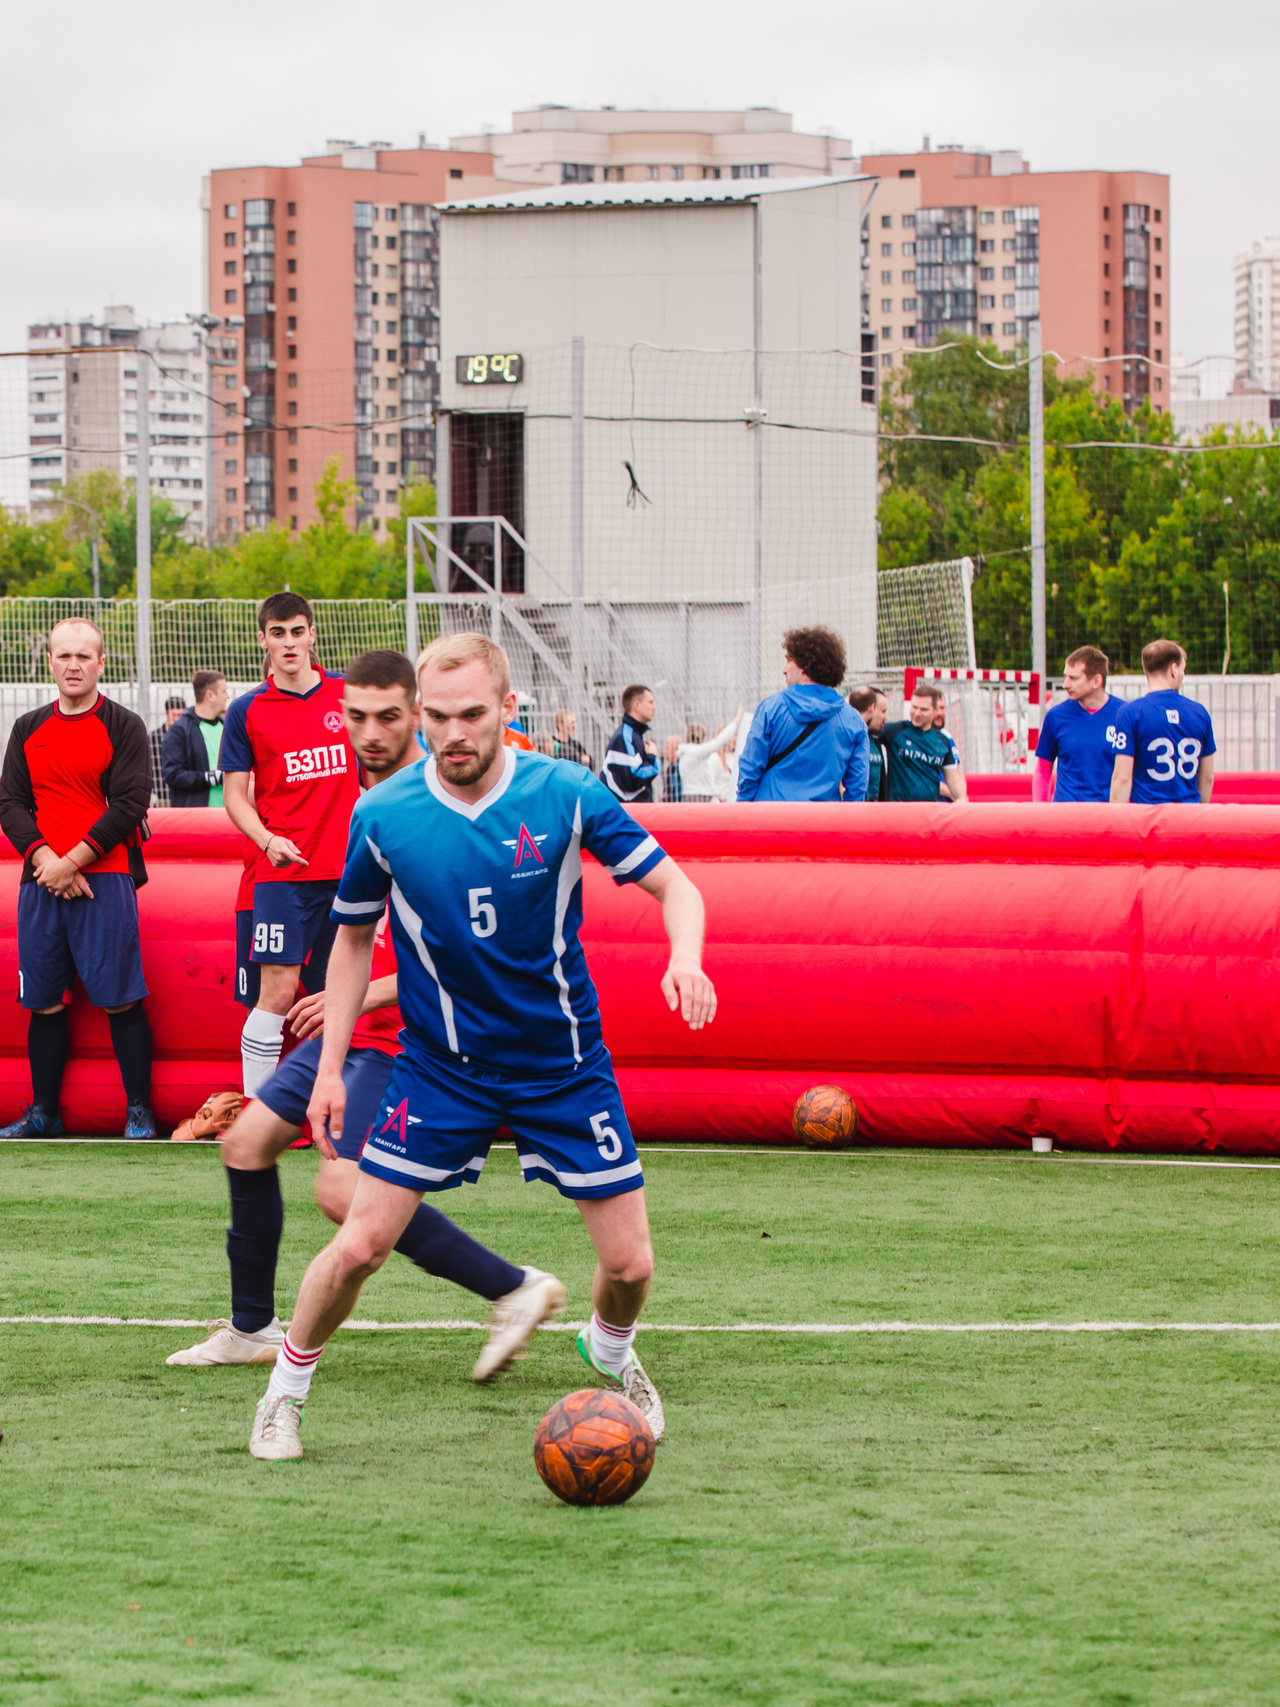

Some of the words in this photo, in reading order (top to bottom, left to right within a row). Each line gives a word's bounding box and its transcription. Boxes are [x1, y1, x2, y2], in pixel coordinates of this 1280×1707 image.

[283, 744, 347, 775] БЗПП
[285, 768, 331, 783] ФУТБОЛЬНЫЙ
[331, 766, 348, 775] КЛУБ
[1146, 737, 1202, 782] 38
[468, 886, 498, 938] 5
[254, 922, 285, 954] 95
[589, 1110, 623, 1161] 5
